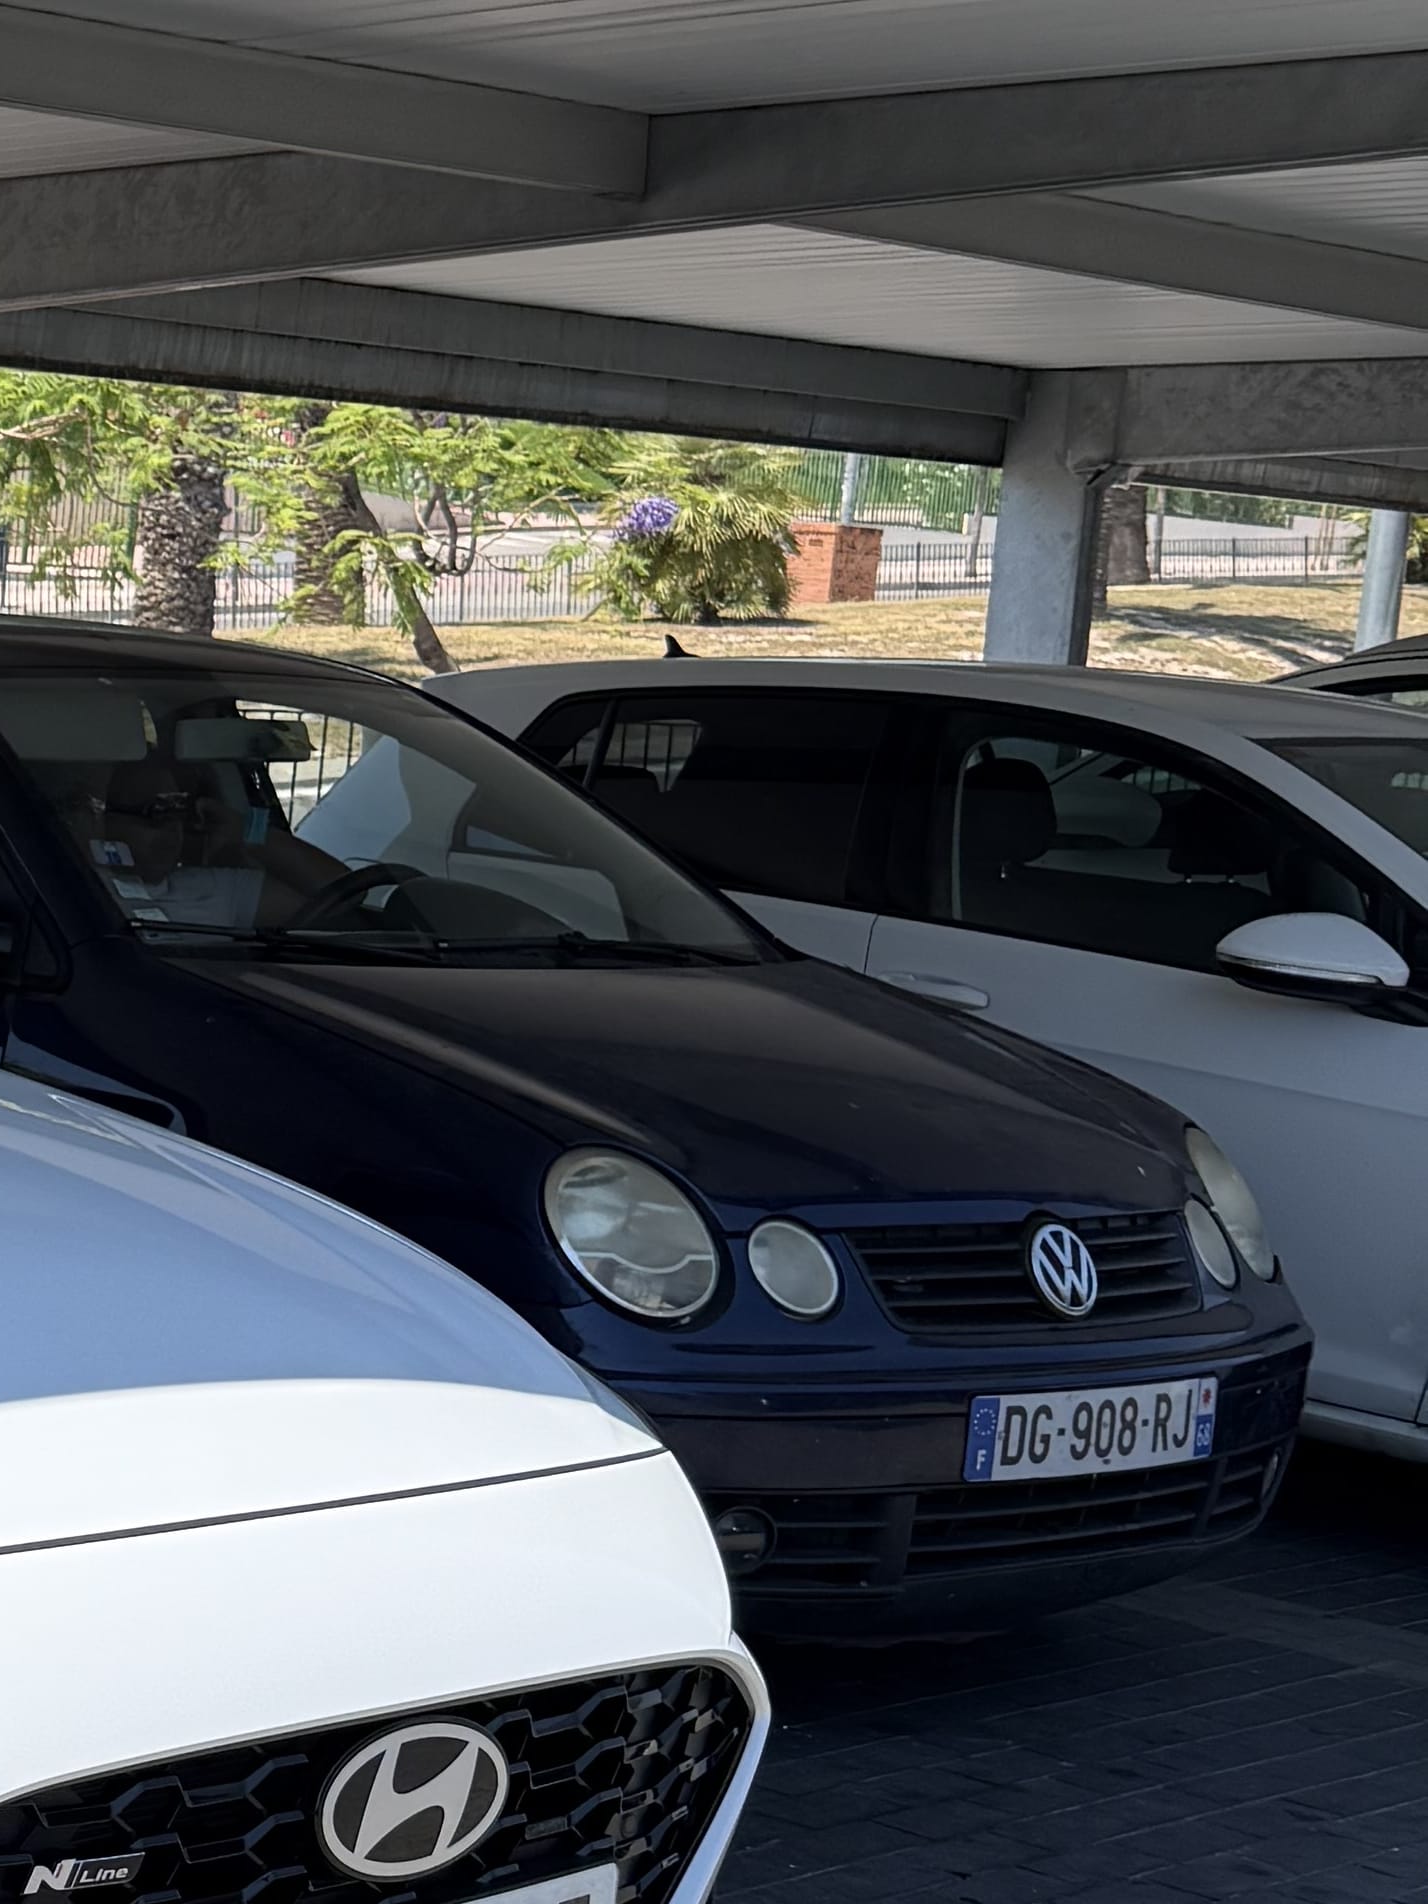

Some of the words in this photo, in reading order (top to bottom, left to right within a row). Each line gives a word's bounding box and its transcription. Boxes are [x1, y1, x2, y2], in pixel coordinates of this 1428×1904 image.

[1000, 1389, 1193, 1466] DG-908-RJ
[975, 1449, 987, 1471] F
[24, 1858, 76, 1894] N
